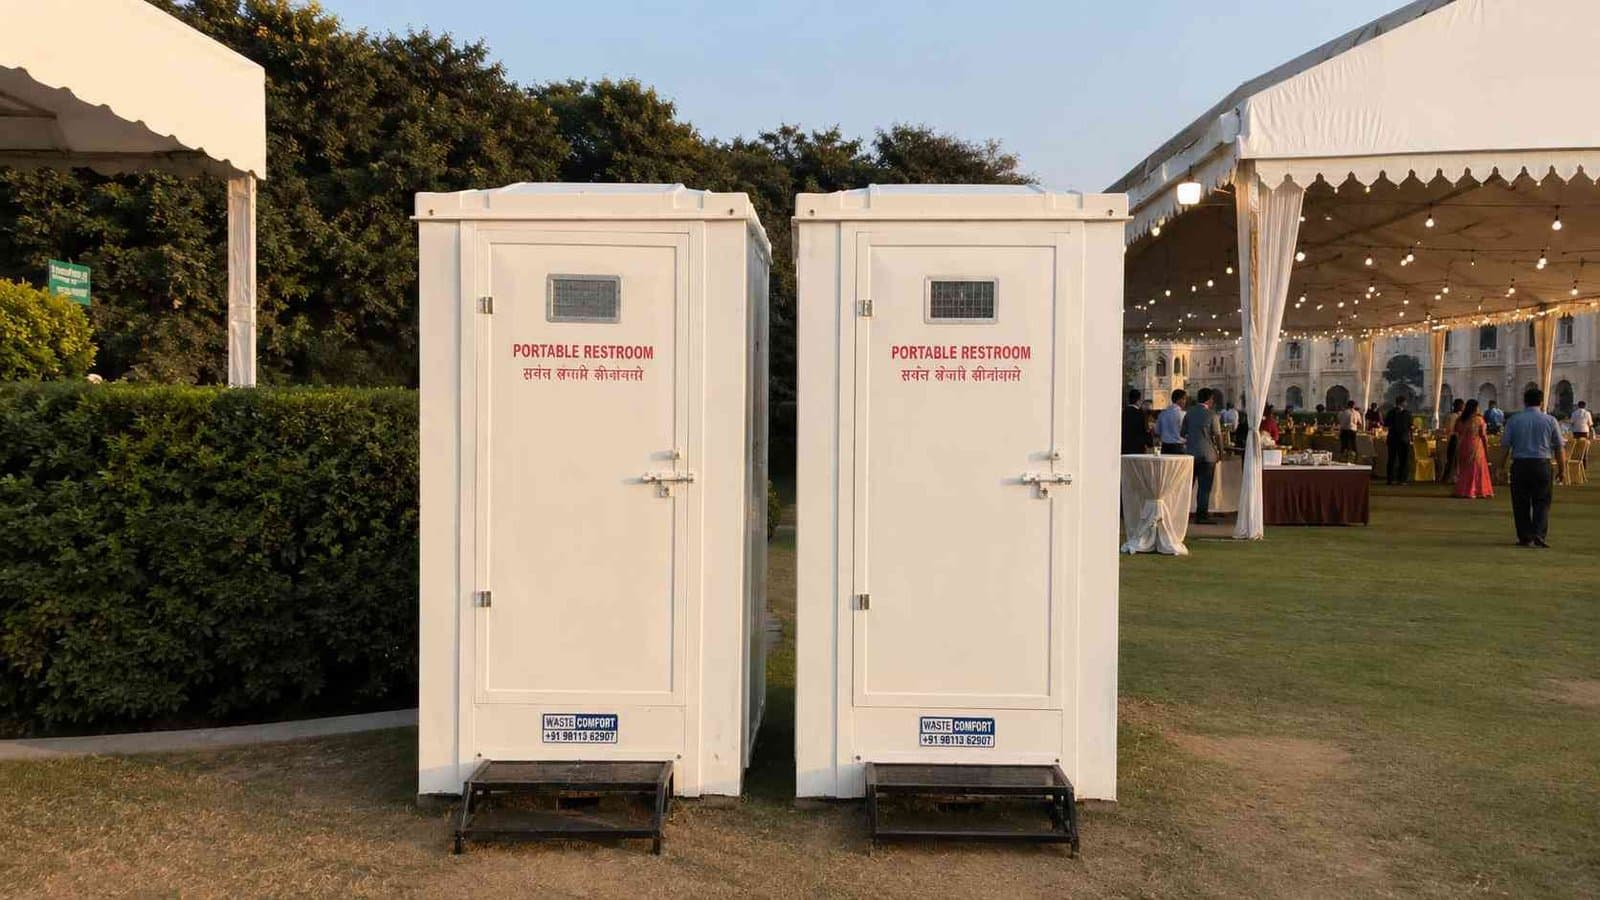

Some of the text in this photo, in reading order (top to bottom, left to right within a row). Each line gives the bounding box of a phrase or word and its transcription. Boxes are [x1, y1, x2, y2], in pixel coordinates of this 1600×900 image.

[513, 344, 654, 359] PORTABLE RESTROOM
[891, 345, 1031, 360] PORTABLE RESTROOM
[545, 717, 616, 728] WASTE COMFORT
[923, 720, 993, 732] WASTE COMFORT
[545, 732, 615, 741] +91 98113 62907
[922, 735, 992, 745] +91 98113 62907
